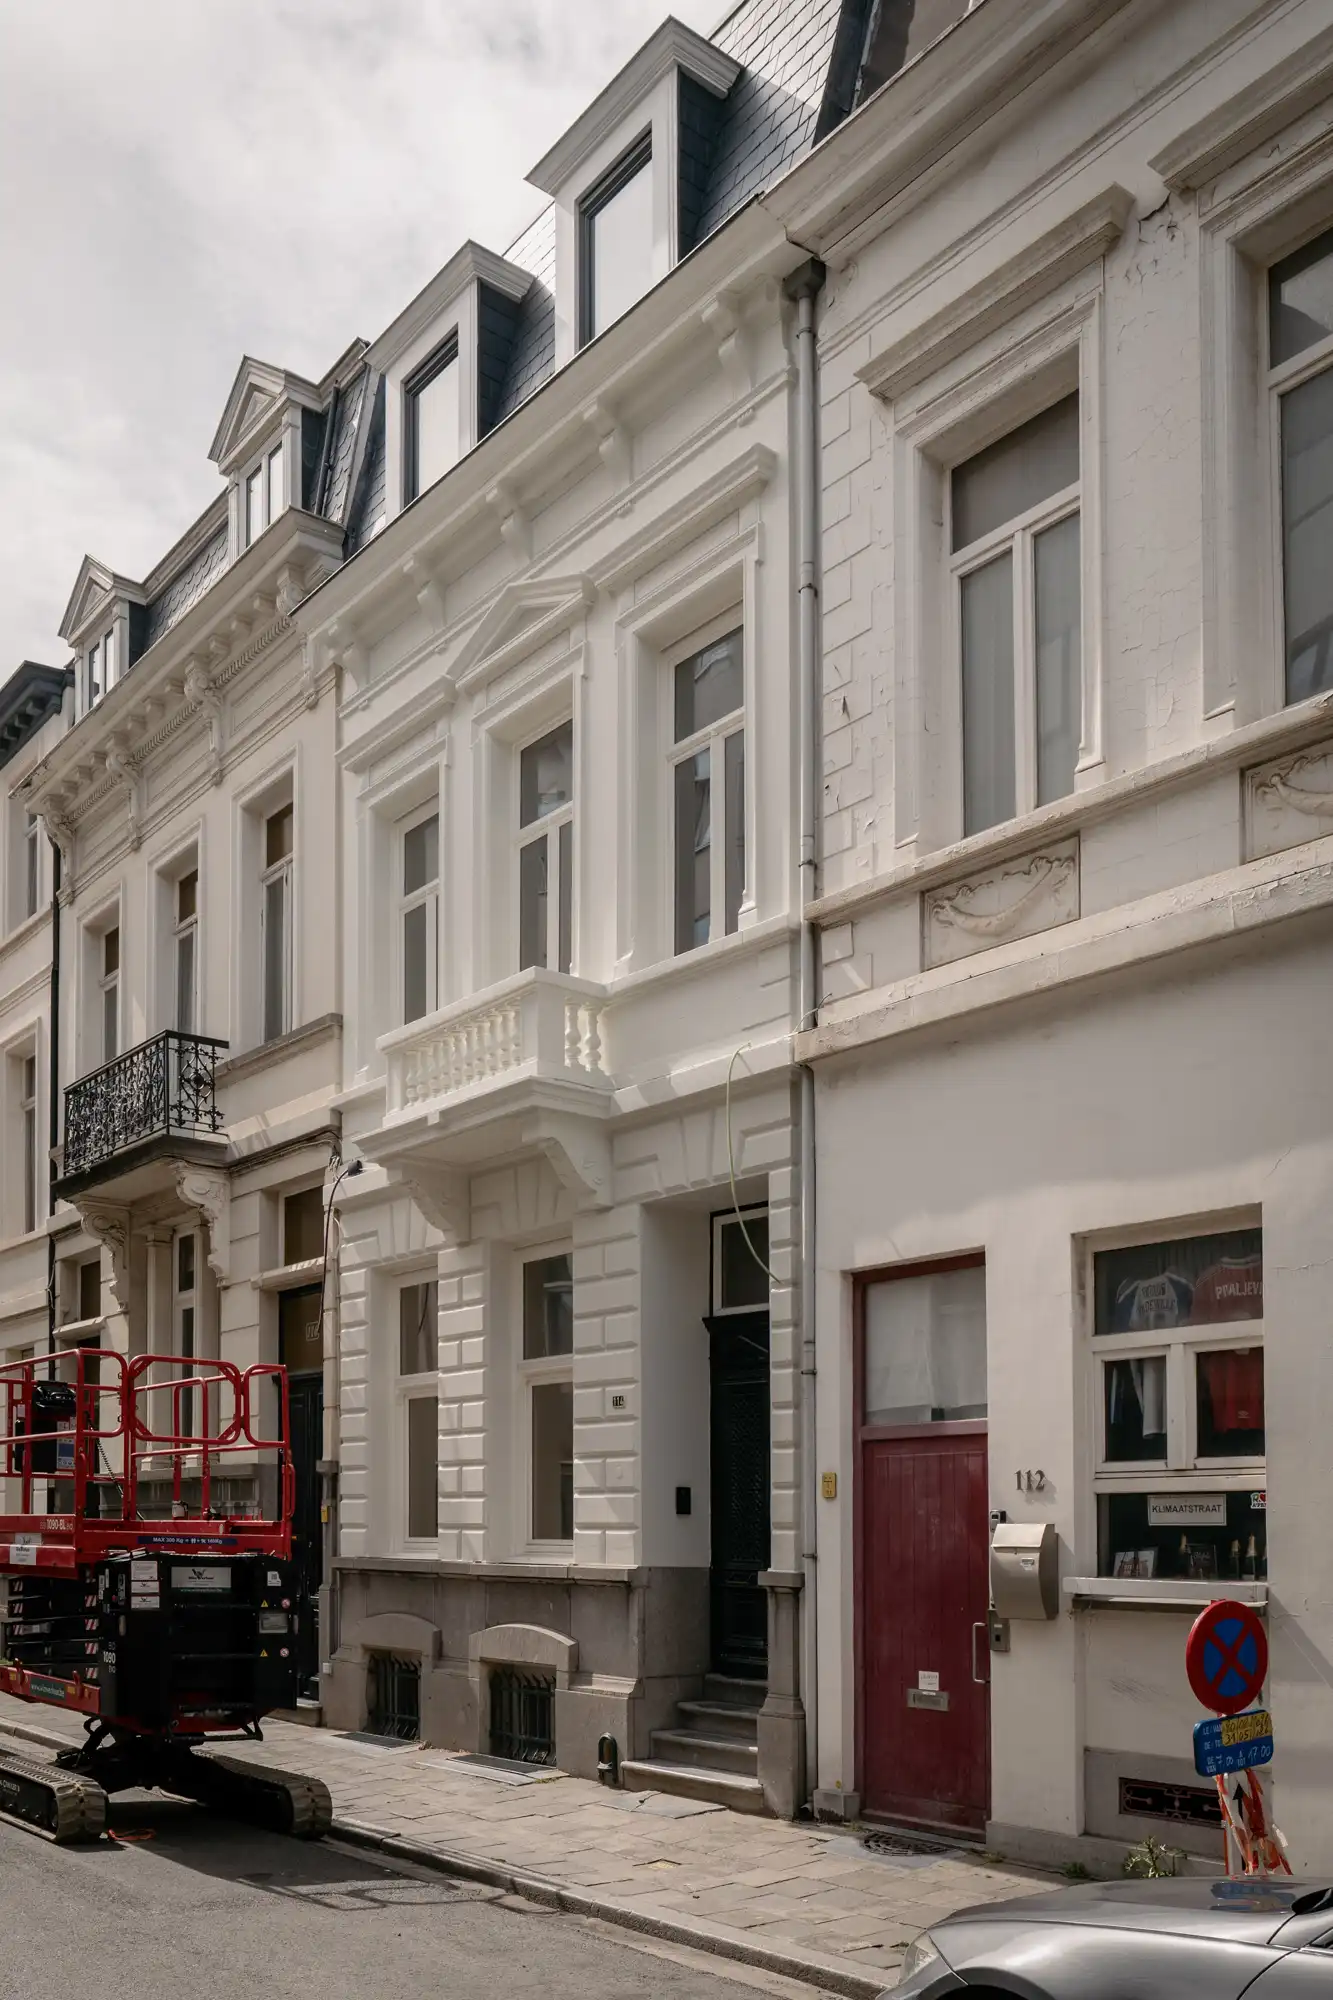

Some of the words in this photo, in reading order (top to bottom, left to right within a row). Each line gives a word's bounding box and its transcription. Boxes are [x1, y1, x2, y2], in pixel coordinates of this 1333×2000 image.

[1014, 1469, 1046, 1491] 112
[1151, 1504, 1223, 1514] KLIMAATSTRAAT
[103, 1650, 116, 1664] 1090
